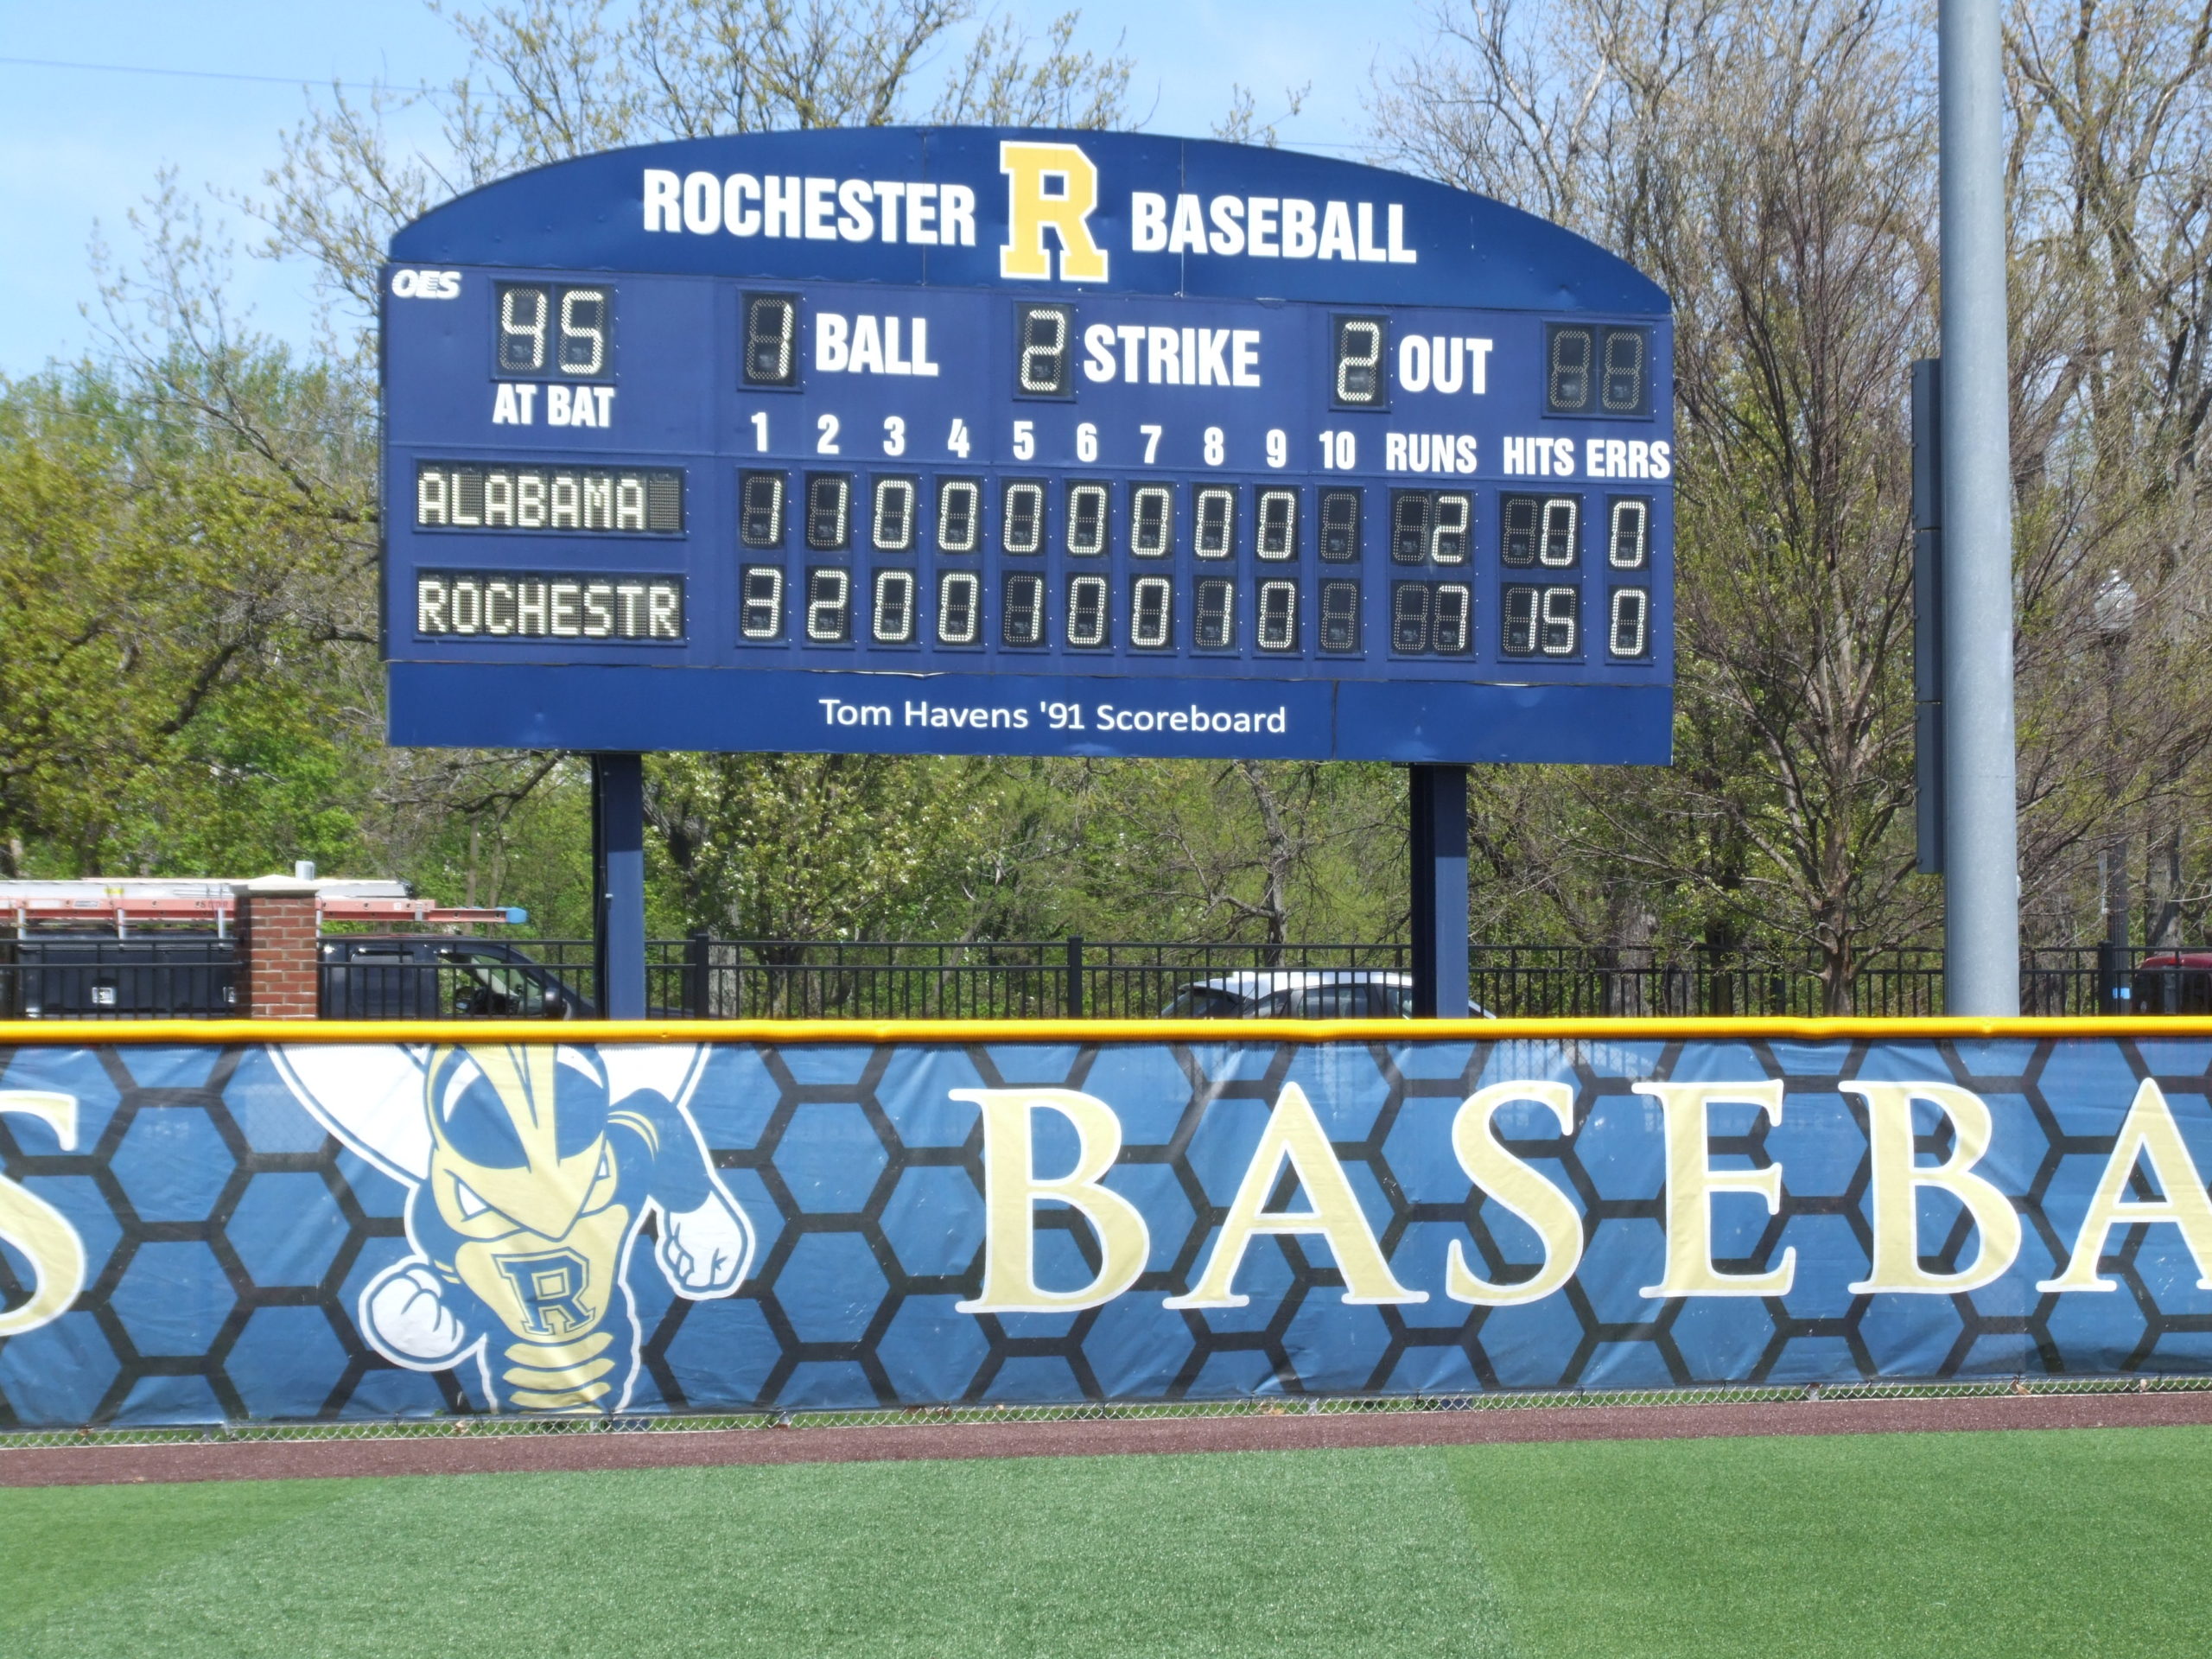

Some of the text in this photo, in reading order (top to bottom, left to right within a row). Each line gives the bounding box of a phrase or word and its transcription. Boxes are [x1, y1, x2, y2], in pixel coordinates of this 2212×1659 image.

[644, 141, 1418, 283] ROCHESTER R BASEBALL
[502, 290, 604, 375] 45
[816, 313, 940, 378] BALL
[1022, 309, 1262, 392] 2 STRIKE
[1338, 321, 1494, 403] 2 OUT
[493, 384, 616, 429] AT BAT
[750, 411, 1673, 481] 1 2 3 4 5 6 7 8 9 10 RUNS HITS ERRS
[418, 473, 645, 530] ALABAMA
[874, 480, 912, 548] 0
[938, 482, 977, 550] 0
[1004, 484, 1041, 551] 0
[1067, 486, 1106, 554] 0
[1131, 488, 1169, 556] 0
[1195, 490, 1232, 557] 0
[1257, 491, 1295, 559] 0
[1432, 496, 1468, 563] 2
[1540, 499, 1576, 566] 0
[1610, 501, 1645, 567] 0
[418, 581, 677, 638] ROCHESTR
[742, 569, 782, 637] 3
[808, 569, 848, 639] 2
[874, 571, 912, 640] 0
[938, 574, 977, 641] 0
[1068, 576, 1106, 645] 0
[1131, 578, 1169, 645] 0
[1258, 582, 1295, 648] 0
[1439, 585, 1468, 648] 7
[1529, 588, 1576, 653] 15
[1610, 589, 1645, 655] 0
[818, 699, 1287, 735] Tom Havens '91 Scoreboard
[948, 1077, 2212, 1315] BASEBA
[490, 1246, 596, 1335] R
